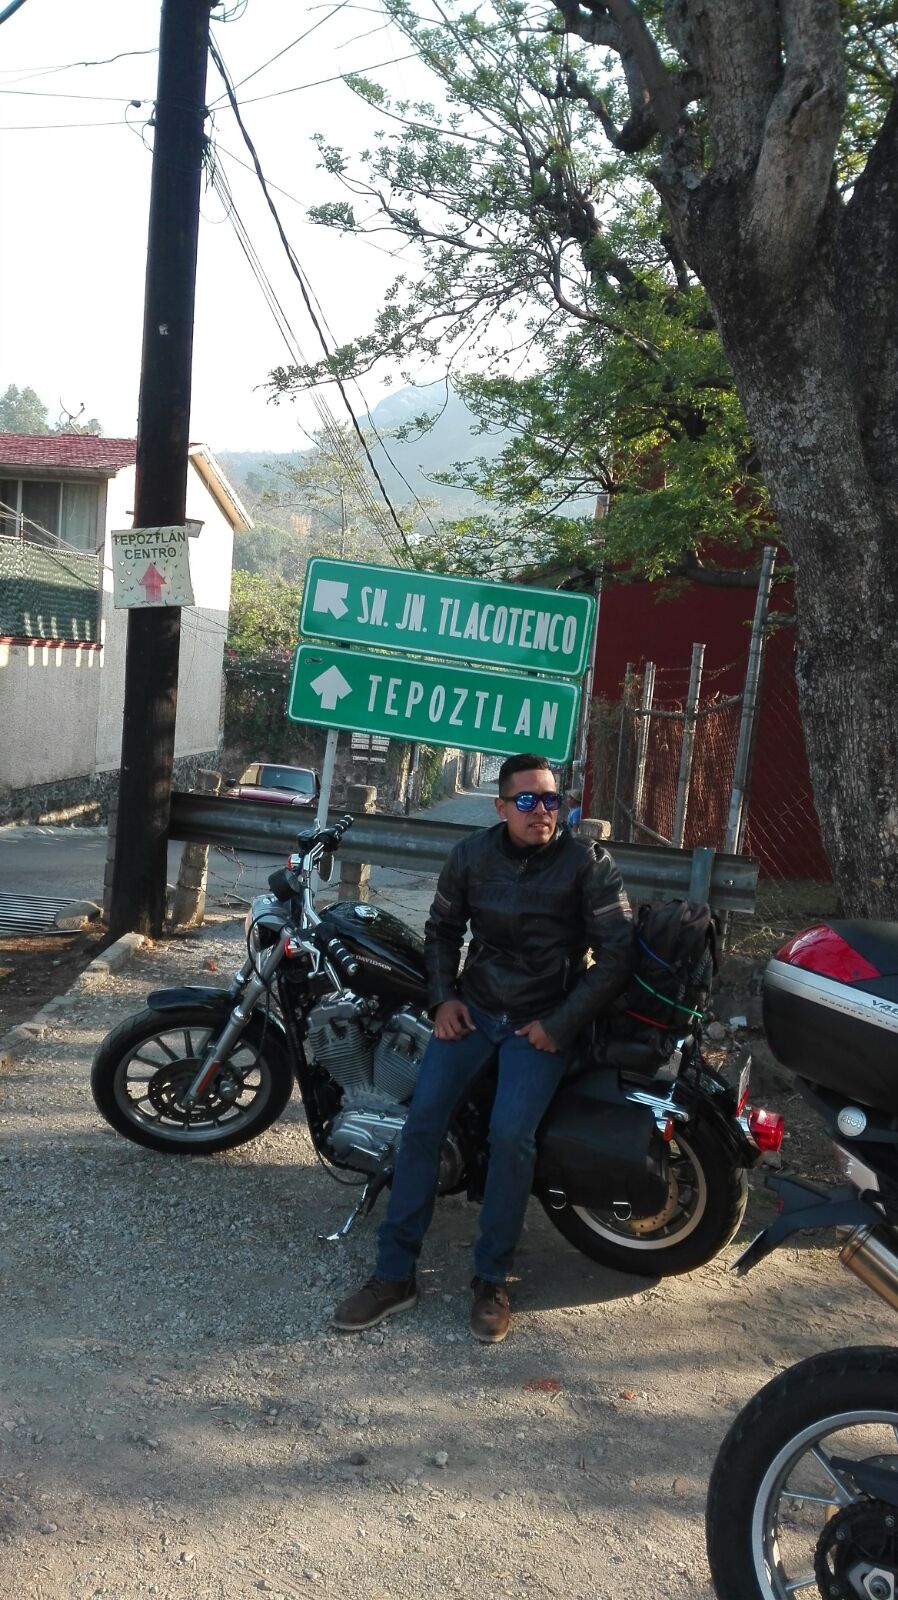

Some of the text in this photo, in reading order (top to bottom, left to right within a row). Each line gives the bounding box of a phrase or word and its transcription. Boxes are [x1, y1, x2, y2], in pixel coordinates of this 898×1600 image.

[112, 529, 186, 546] TEPOZTLÁN
[124, 547, 177, 560] CENTRO
[357, 586, 577, 655] SN. JN. TLACOTENCO
[367, 674, 559, 740] TEPOZTLAN
